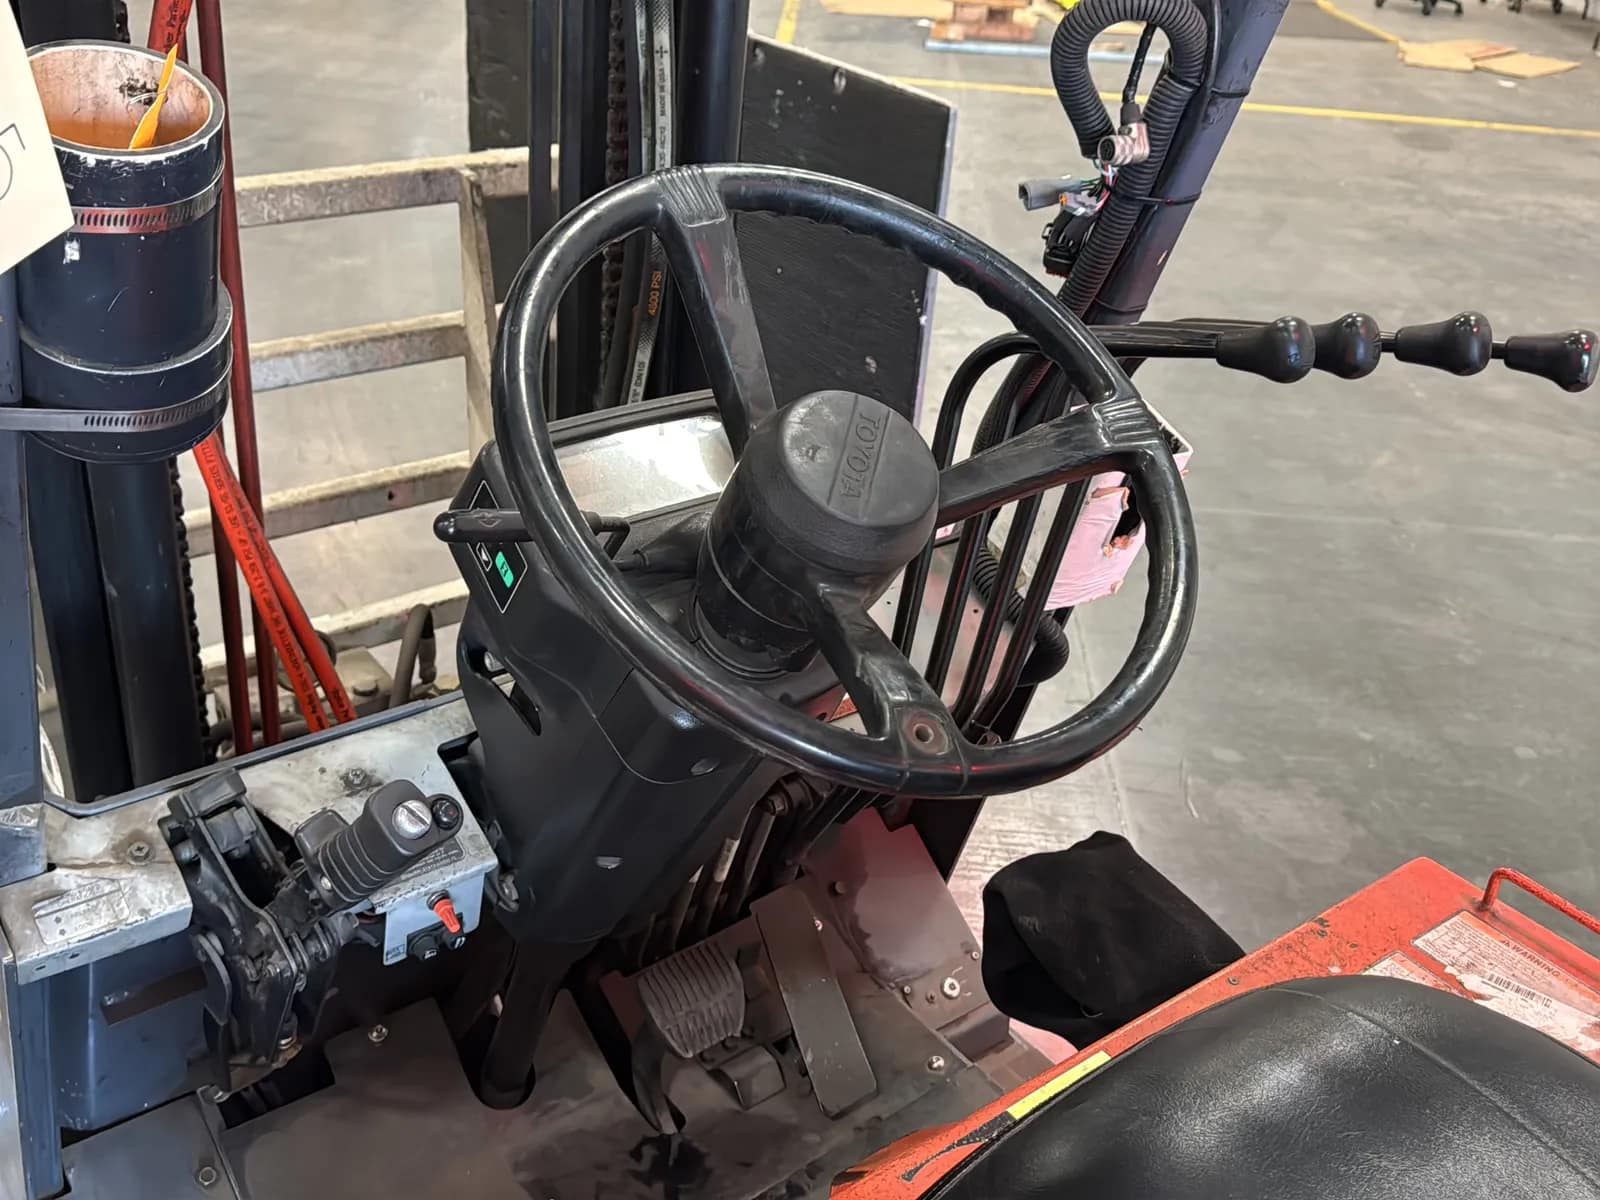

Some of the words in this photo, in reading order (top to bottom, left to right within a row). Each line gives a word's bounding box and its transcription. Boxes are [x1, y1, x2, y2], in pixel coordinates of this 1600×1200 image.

[650, 271, 663, 289] PSI
[840, 412, 880, 498] TOYOTA
[1511, 944, 1561, 977] WARNING
